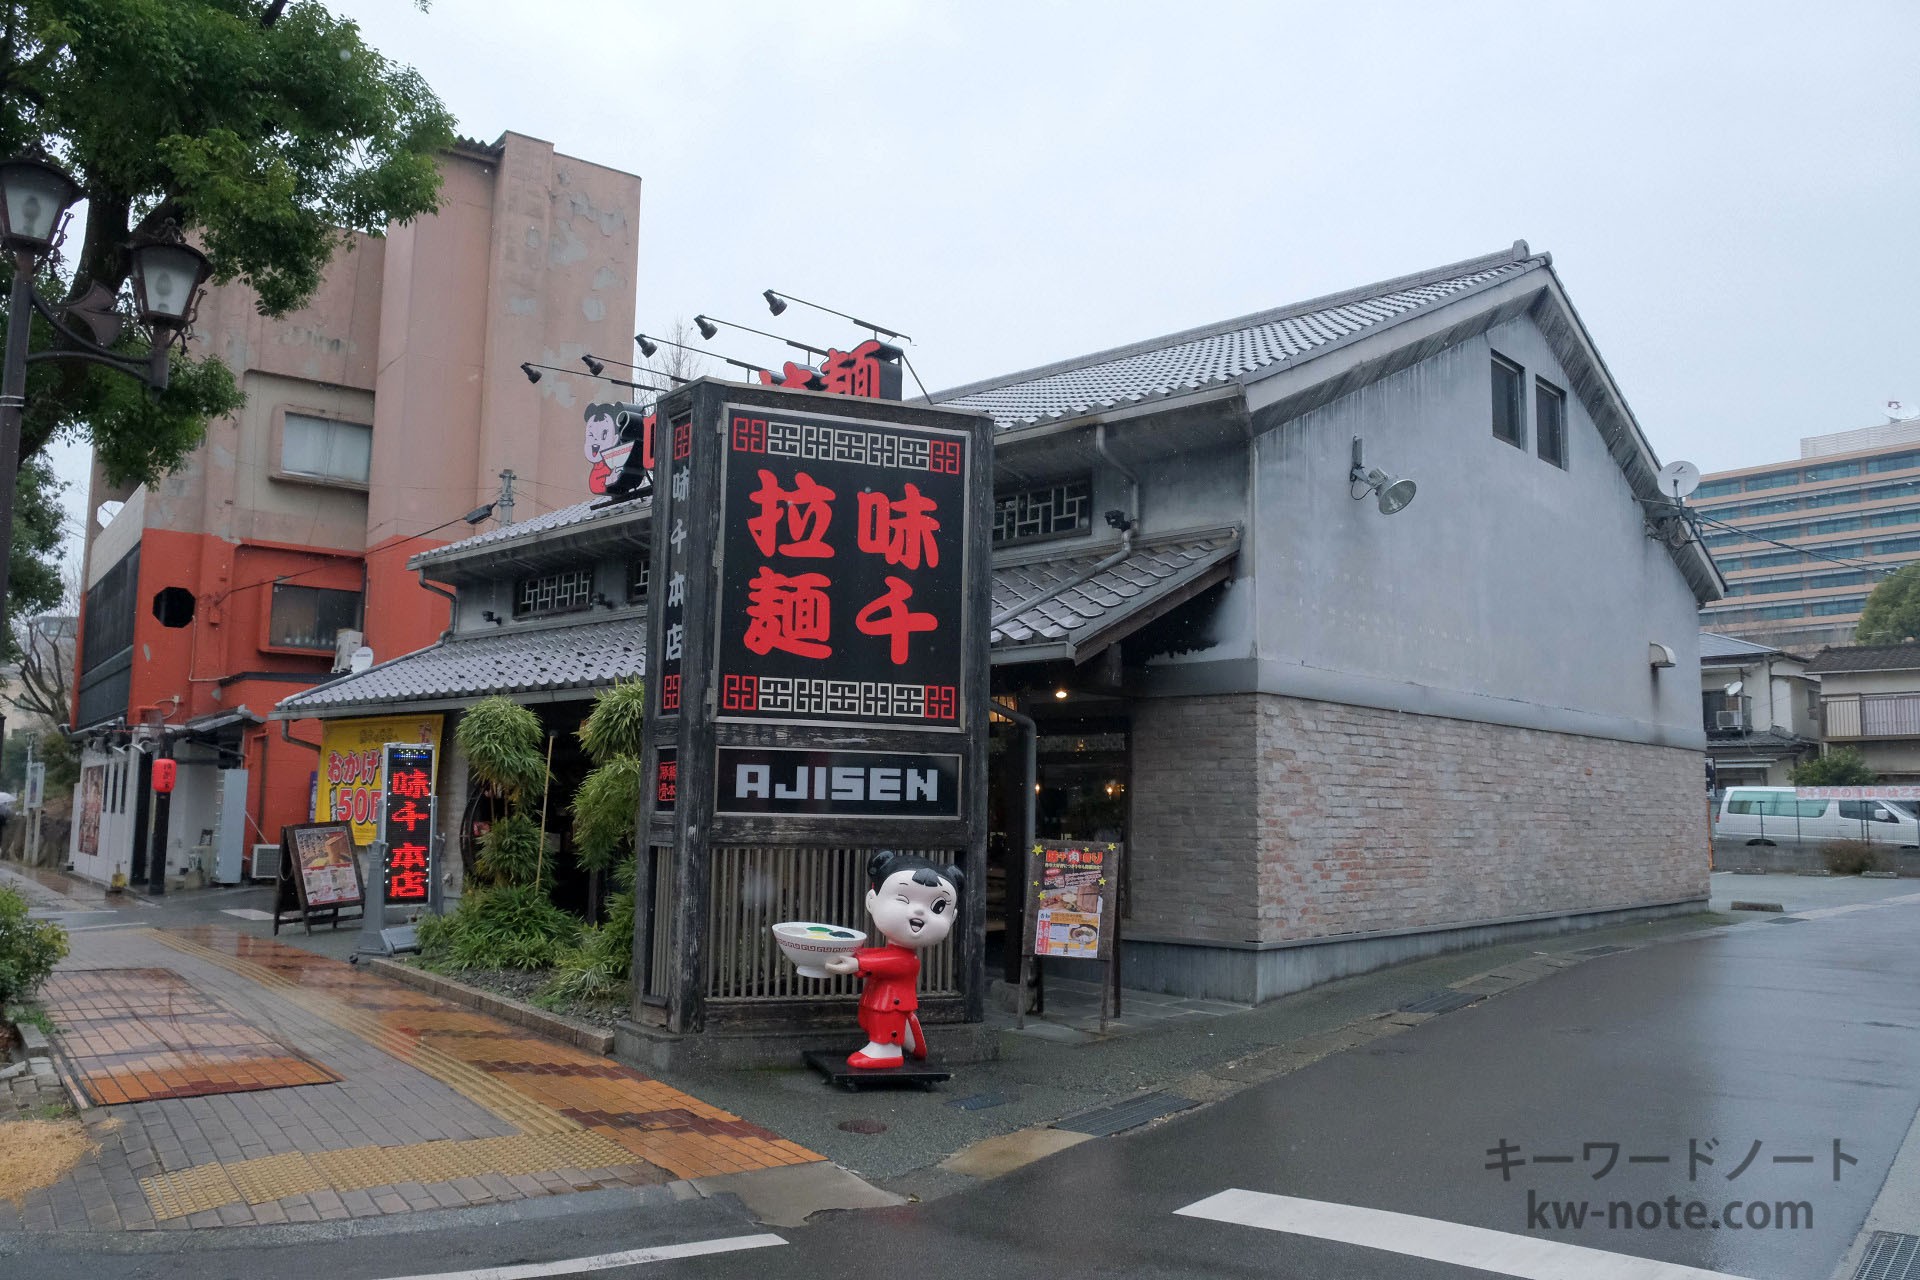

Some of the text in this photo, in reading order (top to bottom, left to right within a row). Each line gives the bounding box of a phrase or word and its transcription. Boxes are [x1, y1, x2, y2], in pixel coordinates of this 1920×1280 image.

[665, 465, 690, 661] 味千本店
[855, 482, 940, 665] 味千
[328, 749, 383, 785] おかげ
[735, 763, 938, 802] AJISEN
[389, 769, 430, 898] 味千本店
